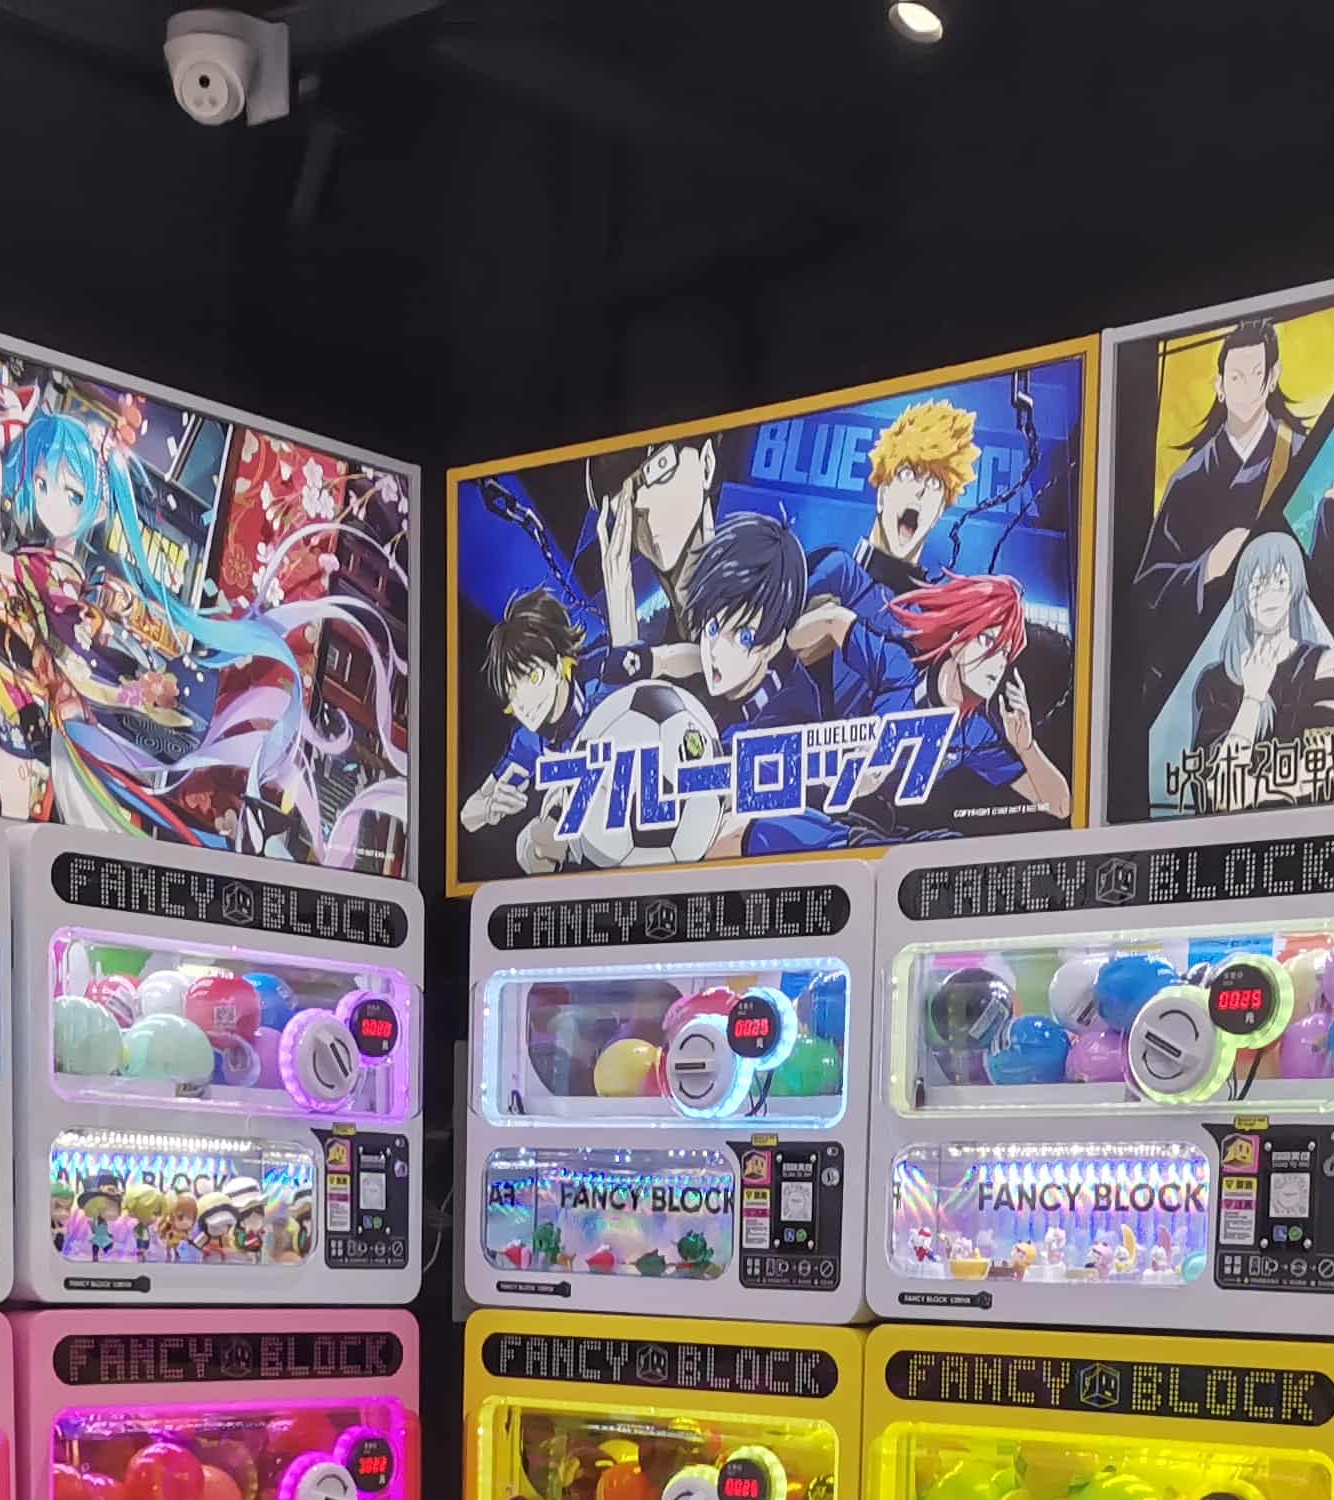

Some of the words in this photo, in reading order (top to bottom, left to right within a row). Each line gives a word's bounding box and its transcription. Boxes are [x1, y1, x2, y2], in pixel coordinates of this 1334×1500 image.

[750, 421, 870, 491] BLUE
[805, 721, 876, 748] BLUELOCK
[535, 707, 960, 842] ブルーロック
[69, 858, 214, 919] FANCY
[263, 887, 390, 943] BLOCK
[507, 900, 638, 946] FANCY
[687, 890, 833, 938] BLOCK
[920, 859, 1086, 918] FANCY
[559, 1184, 643, 1211] FANCY
[979, 1182, 1084, 1212] FANCY
[1092, 1182, 1206, 1212] BLOCK
[69, 1338, 213, 1381] FANCY
[261, 1335, 387, 1377] BLOCK
[500, 1336, 629, 1381] FANCY
[677, 1345, 820, 1395] BLOCK
[908, 1353, 1071, 1405] FANCY
[1132, 1365, 1314, 1421] BLOCK
